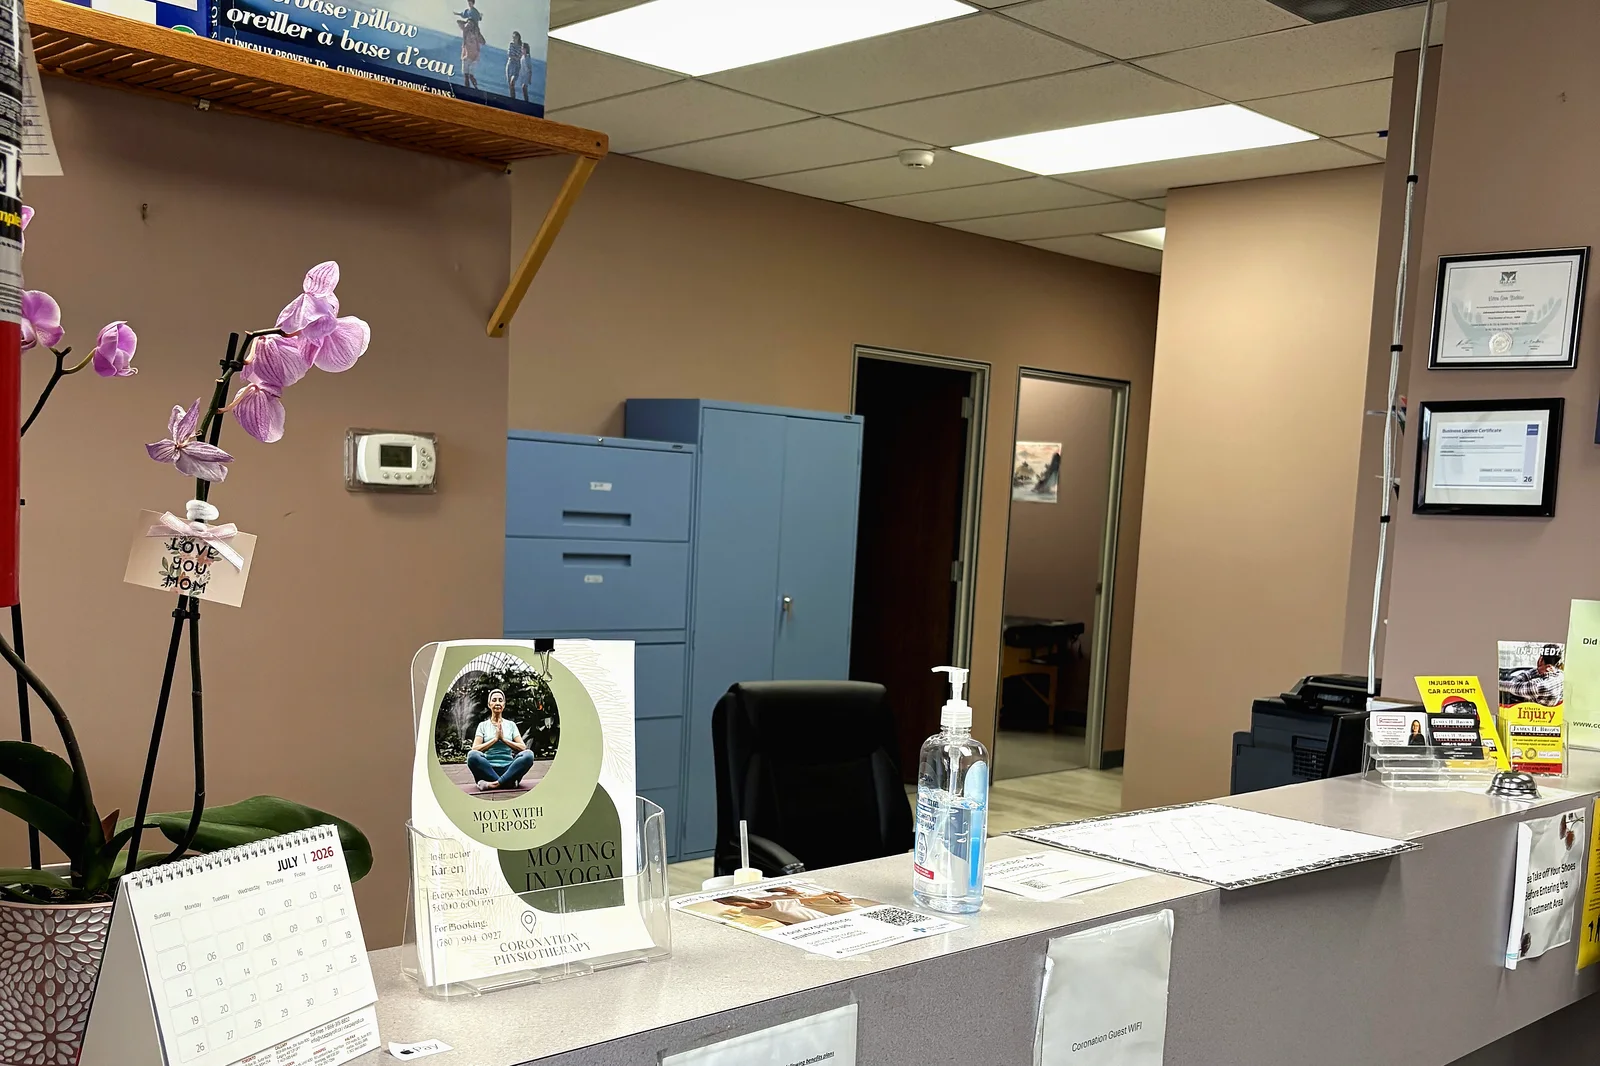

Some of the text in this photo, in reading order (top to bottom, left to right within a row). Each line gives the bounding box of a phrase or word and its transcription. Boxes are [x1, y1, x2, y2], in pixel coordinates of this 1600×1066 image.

[350, 7, 419, 38] pillow
[226, 7, 455, 77] oreiller à base d'eau
[224, 37, 274, 55] CLINICALLY
[336, 64, 396, 85] CLINIQUEMENT
[170, 537, 216, 559] LOVE
[165, 574, 207, 594] MOM
[1515, 647, 1561, 656] INJURED?
[1582, 637, 1598, 645] Did
[1517, 707, 1556, 724] Injury
[473, 806, 544, 822] MOVE WITH
[481, 818, 537, 834] PURPOSE
[277, 846, 334, 872] JULY 2026
[526, 840, 617, 868] MOVING
[431, 865, 465, 876] Karen
[525, 864, 616, 892] IN YOGA
[1532, 870, 1542, 882] Take
[1542, 867, 1551, 879] off
[1550, 866, 1561, 877] Your
[1561, 862, 1576, 873] Shoes
[153, 911, 171, 920] Sunday
[184, 902, 202, 911] Monday
[212, 894, 230, 902] Tuesday
[237, 885, 261, 895] Wednesday
[266, 878, 284, 886] Thursday
[316, 863, 333, 871] Saturday
[456, 886, 490, 897] Monday
[1539, 882, 1560, 896] Entering
[1560, 879, 1569, 890] the
[258, 884, 342, 916] 01 02 03 04
[1528, 898, 1564, 917] Treatment Area
[176, 908, 345, 972] 05 06 07 08 09 10 11
[434, 924, 447, 933] For
[493, 941, 592, 966] PHYSIOTHERAPY
[499, 932, 581, 953] CORONATION
[185, 930, 352, 997] 12 13 14 15 16 17 18
[190, 954, 357, 1025] 19 20 21 22 23 24 25
[195, 987, 339, 1053] 26 27 28 29 30 31
[1071, 1033, 1108, 1052] Coronation
[1108, 1027, 1128, 1040] Guest
